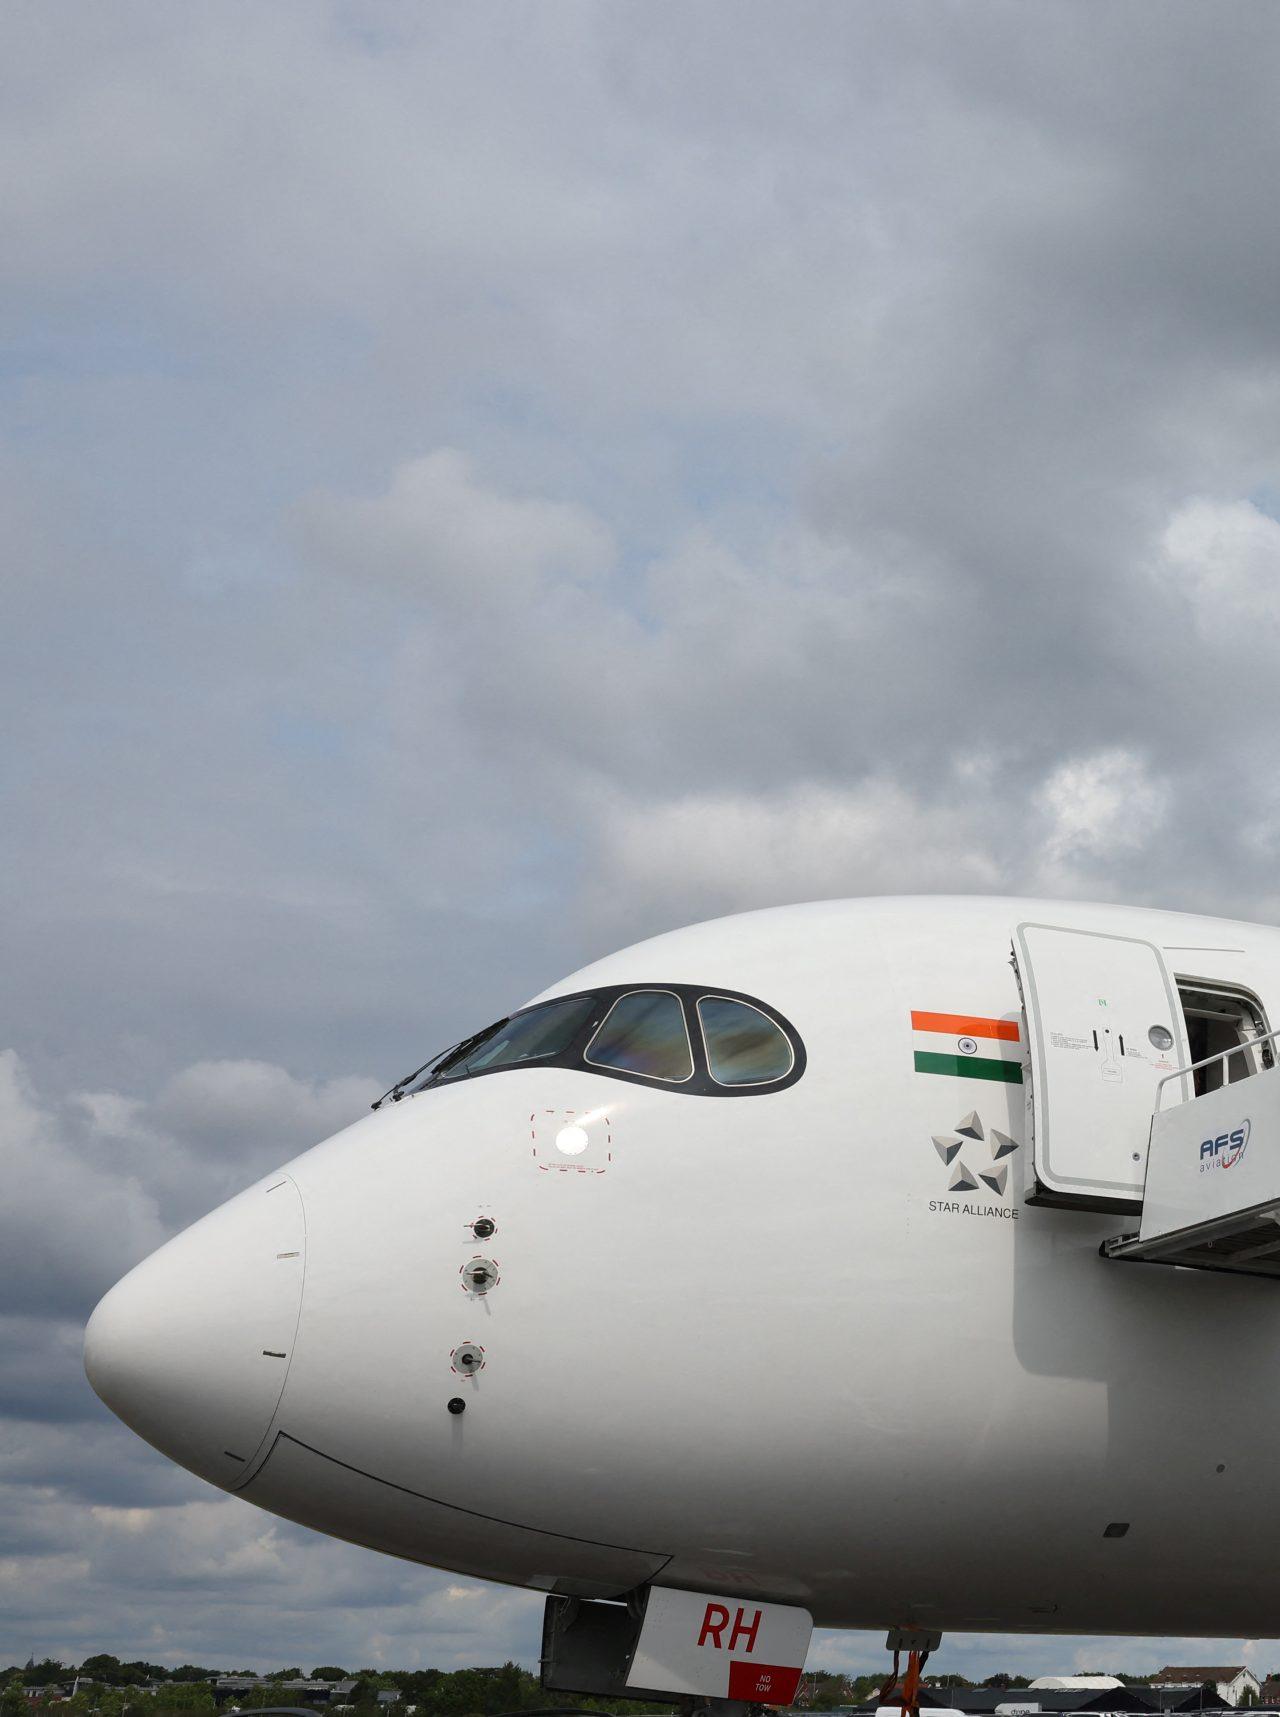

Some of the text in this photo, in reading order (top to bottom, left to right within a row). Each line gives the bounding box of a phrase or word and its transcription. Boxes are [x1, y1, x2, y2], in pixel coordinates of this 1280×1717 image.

[1200, 1128, 1244, 1160] AFS
[1199, 1151, 1244, 1173] aviation
[928, 1200, 1020, 1220] STAR ALLIANCE
[697, 1603, 762, 1653] RH
[755, 1683, 772, 1693] TOW
[760, 1675, 772, 1683] NO
